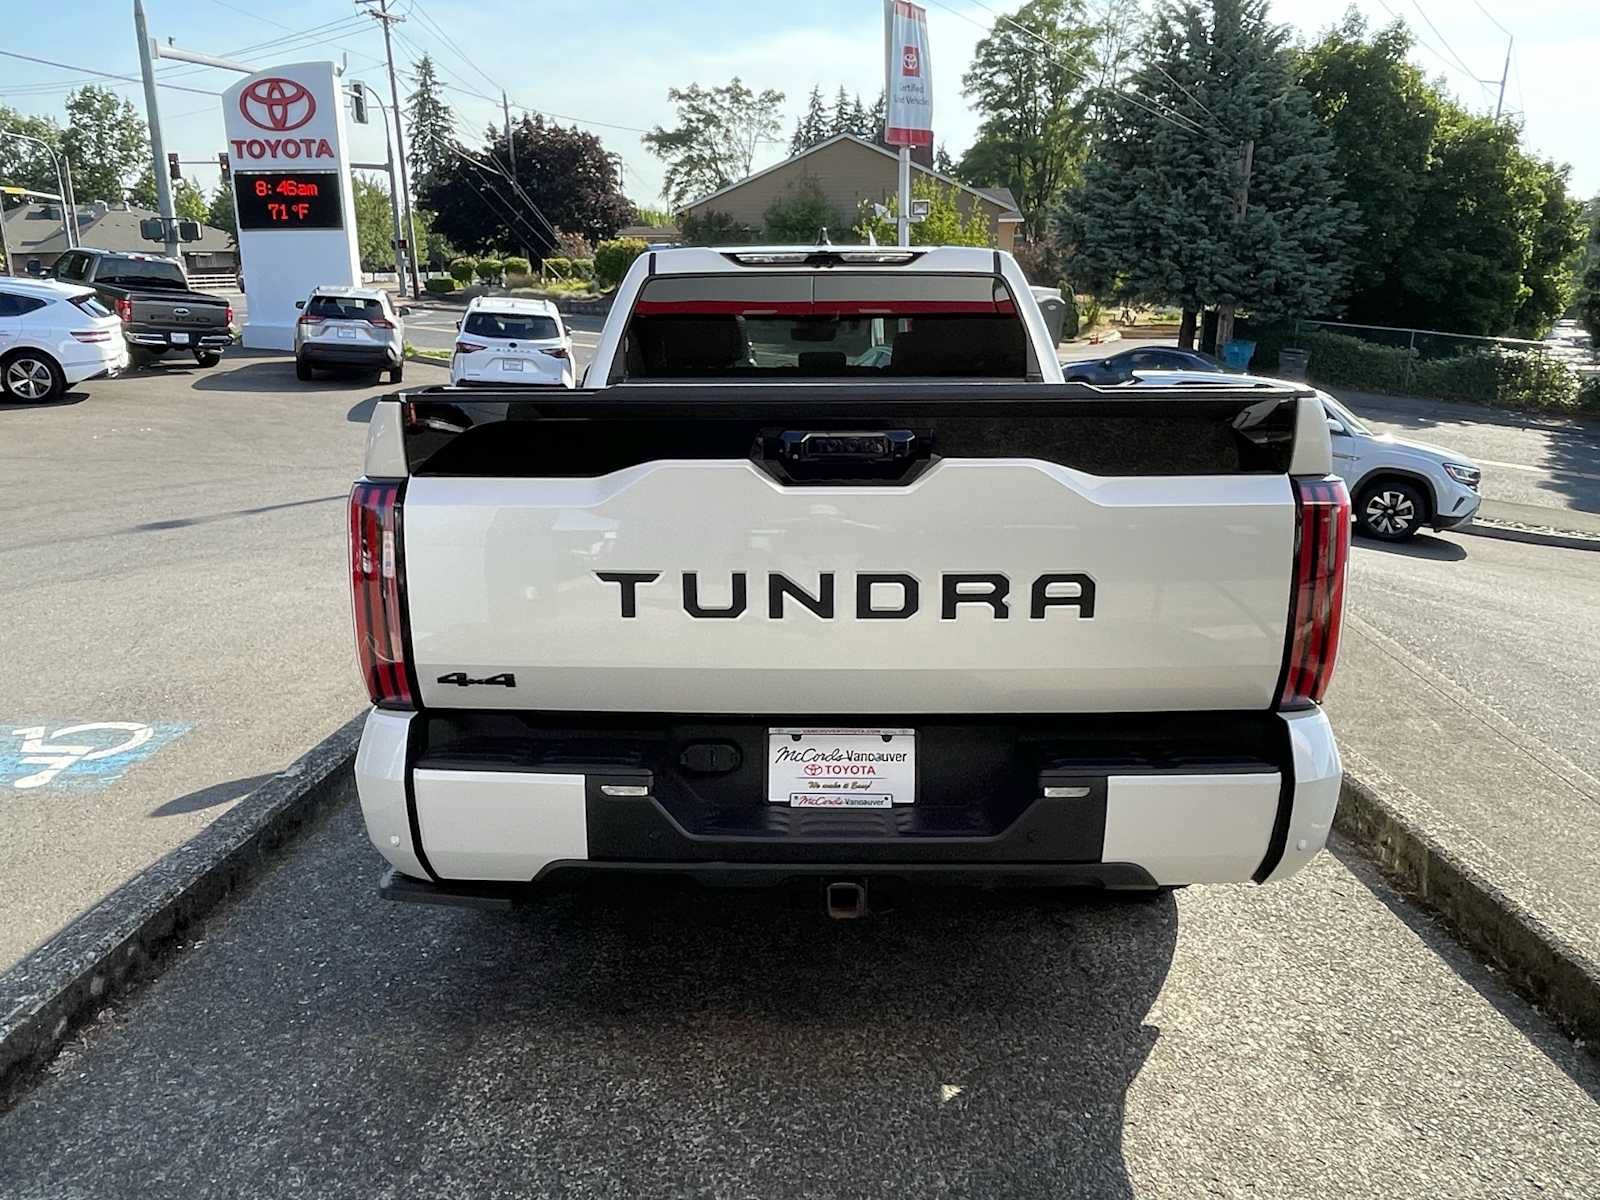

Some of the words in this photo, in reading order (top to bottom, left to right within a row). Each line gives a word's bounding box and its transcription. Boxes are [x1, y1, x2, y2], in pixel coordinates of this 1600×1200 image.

[230, 138, 335, 160] TOYOTA
[595, 571, 1097, 619] TUNDRA
[825, 765, 876, 776] TOYOTA
